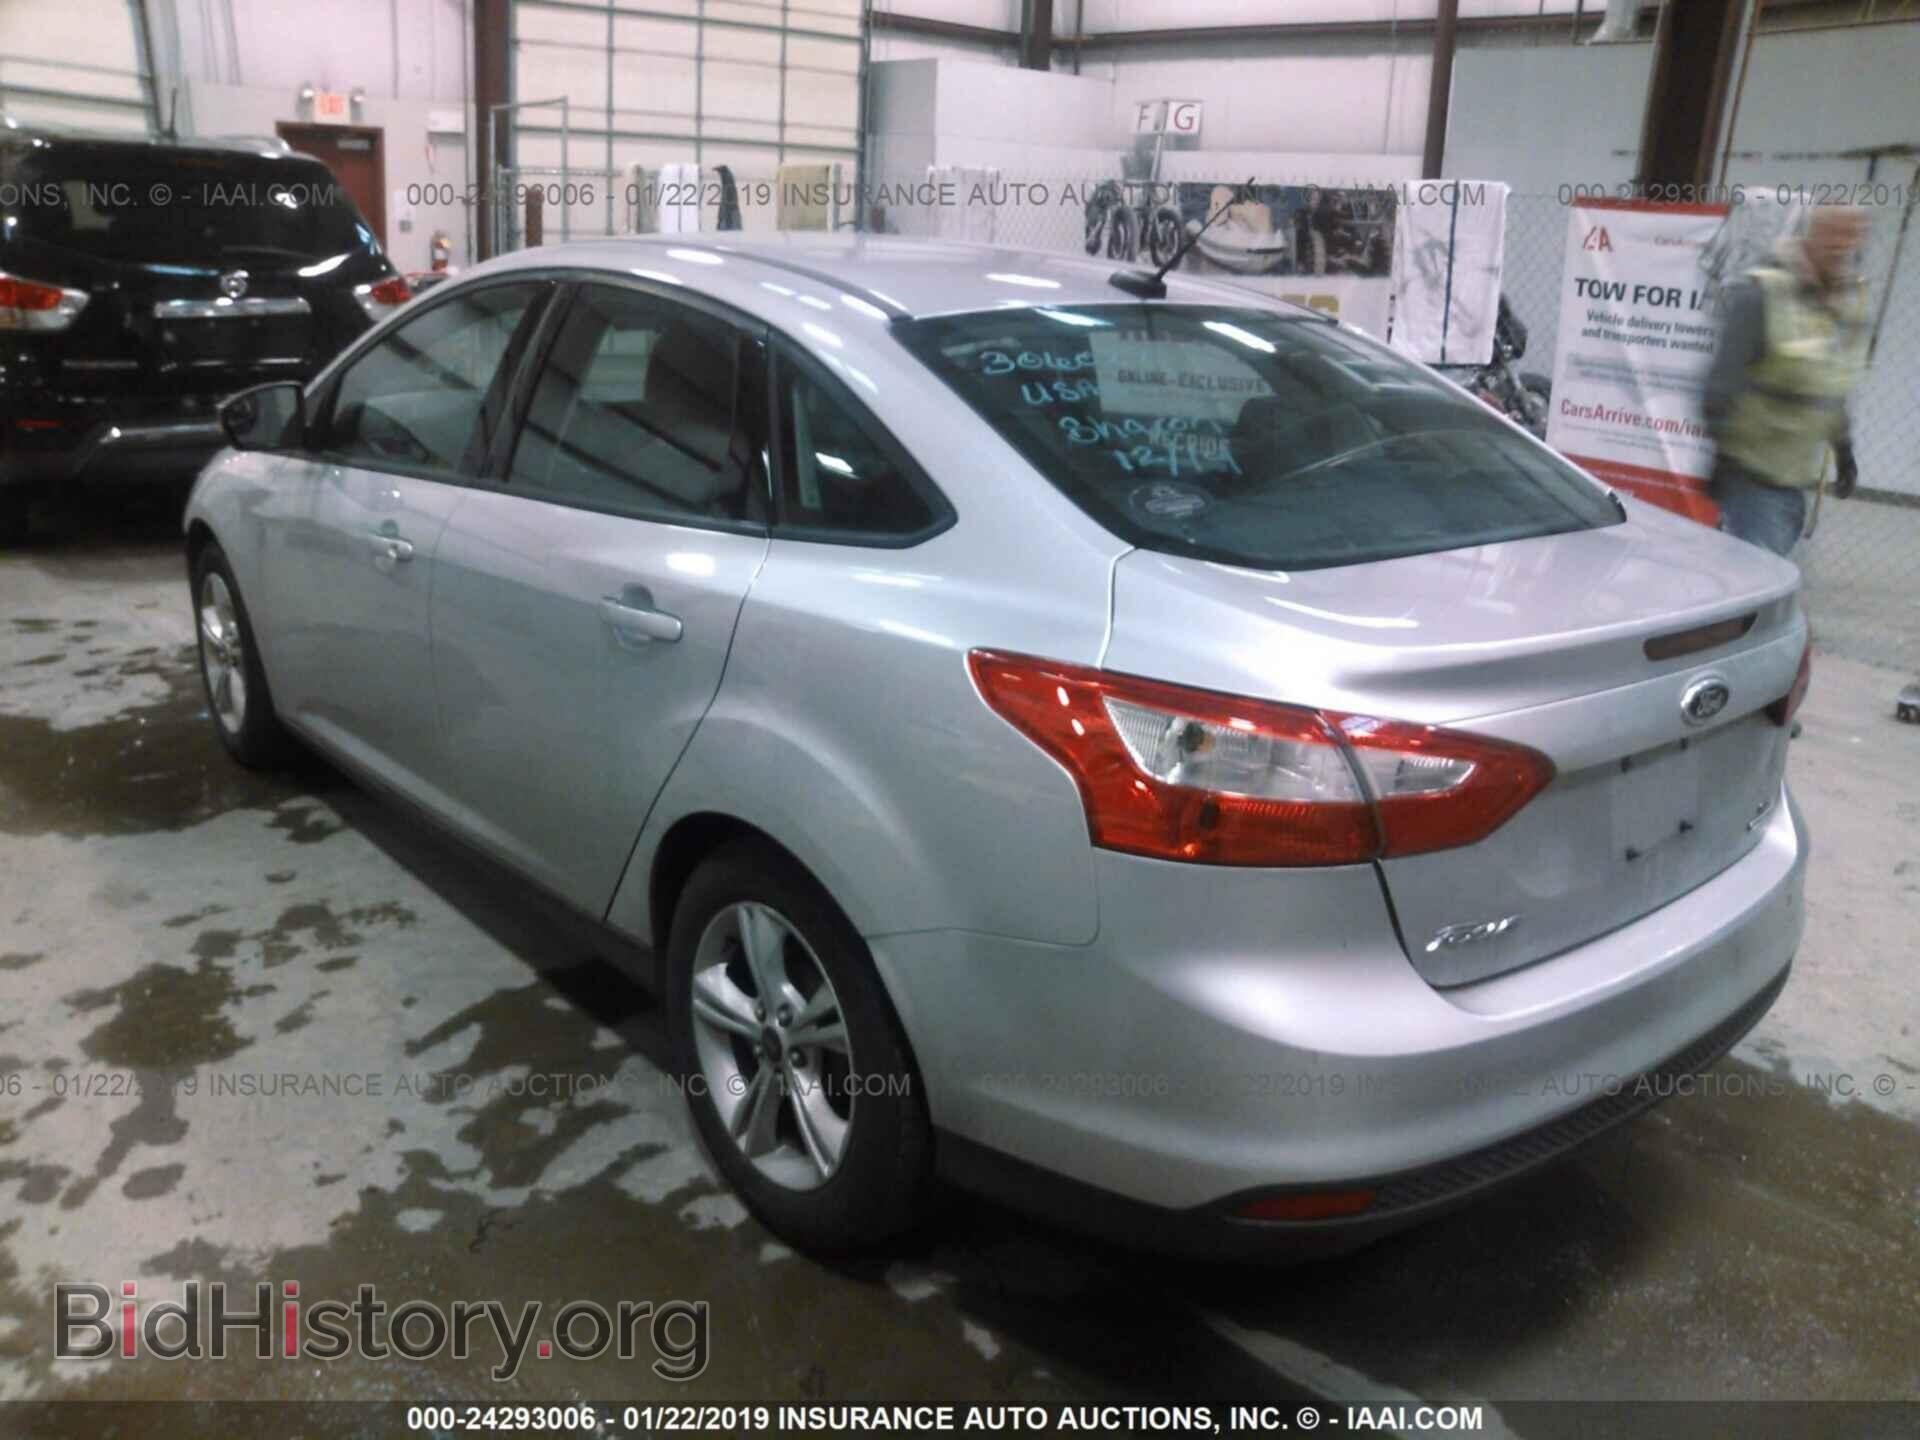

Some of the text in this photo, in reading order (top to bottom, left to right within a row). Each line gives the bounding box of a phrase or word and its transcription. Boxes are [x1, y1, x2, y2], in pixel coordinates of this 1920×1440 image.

[1137, 102, 1152, 131] F
[1173, 103, 1196, 131] G
[1574, 277, 1626, 302] TOW
[1632, 284, 1682, 310] FOR
[1586, 308, 1624, 326] Vehicle
[1627, 315, 1671, 335] delivery
[1581, 326, 1601, 339] and
[1669, 339, 1713, 354] wanted
